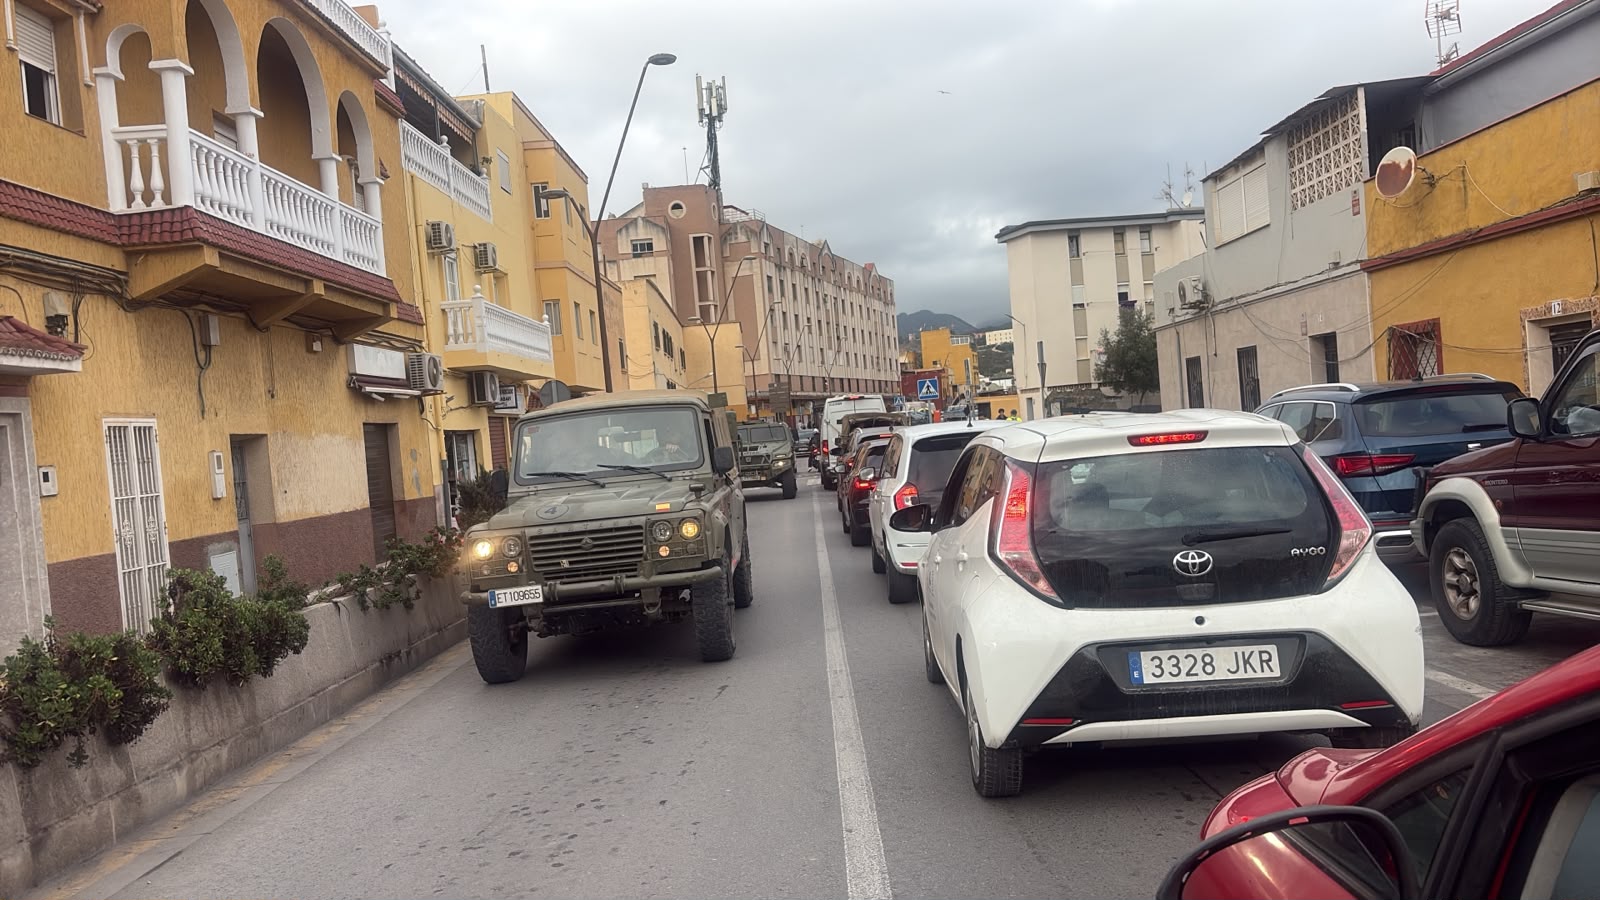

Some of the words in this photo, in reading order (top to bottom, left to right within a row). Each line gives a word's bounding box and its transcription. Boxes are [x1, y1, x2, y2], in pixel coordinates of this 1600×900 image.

[544, 505, 557, 515] 4
[1291, 546, 1326, 557] AYGO
[496, 588, 541, 604] ET109655
[1150, 653, 1216, 679] 3328
[1226, 650, 1275, 675] JKR
